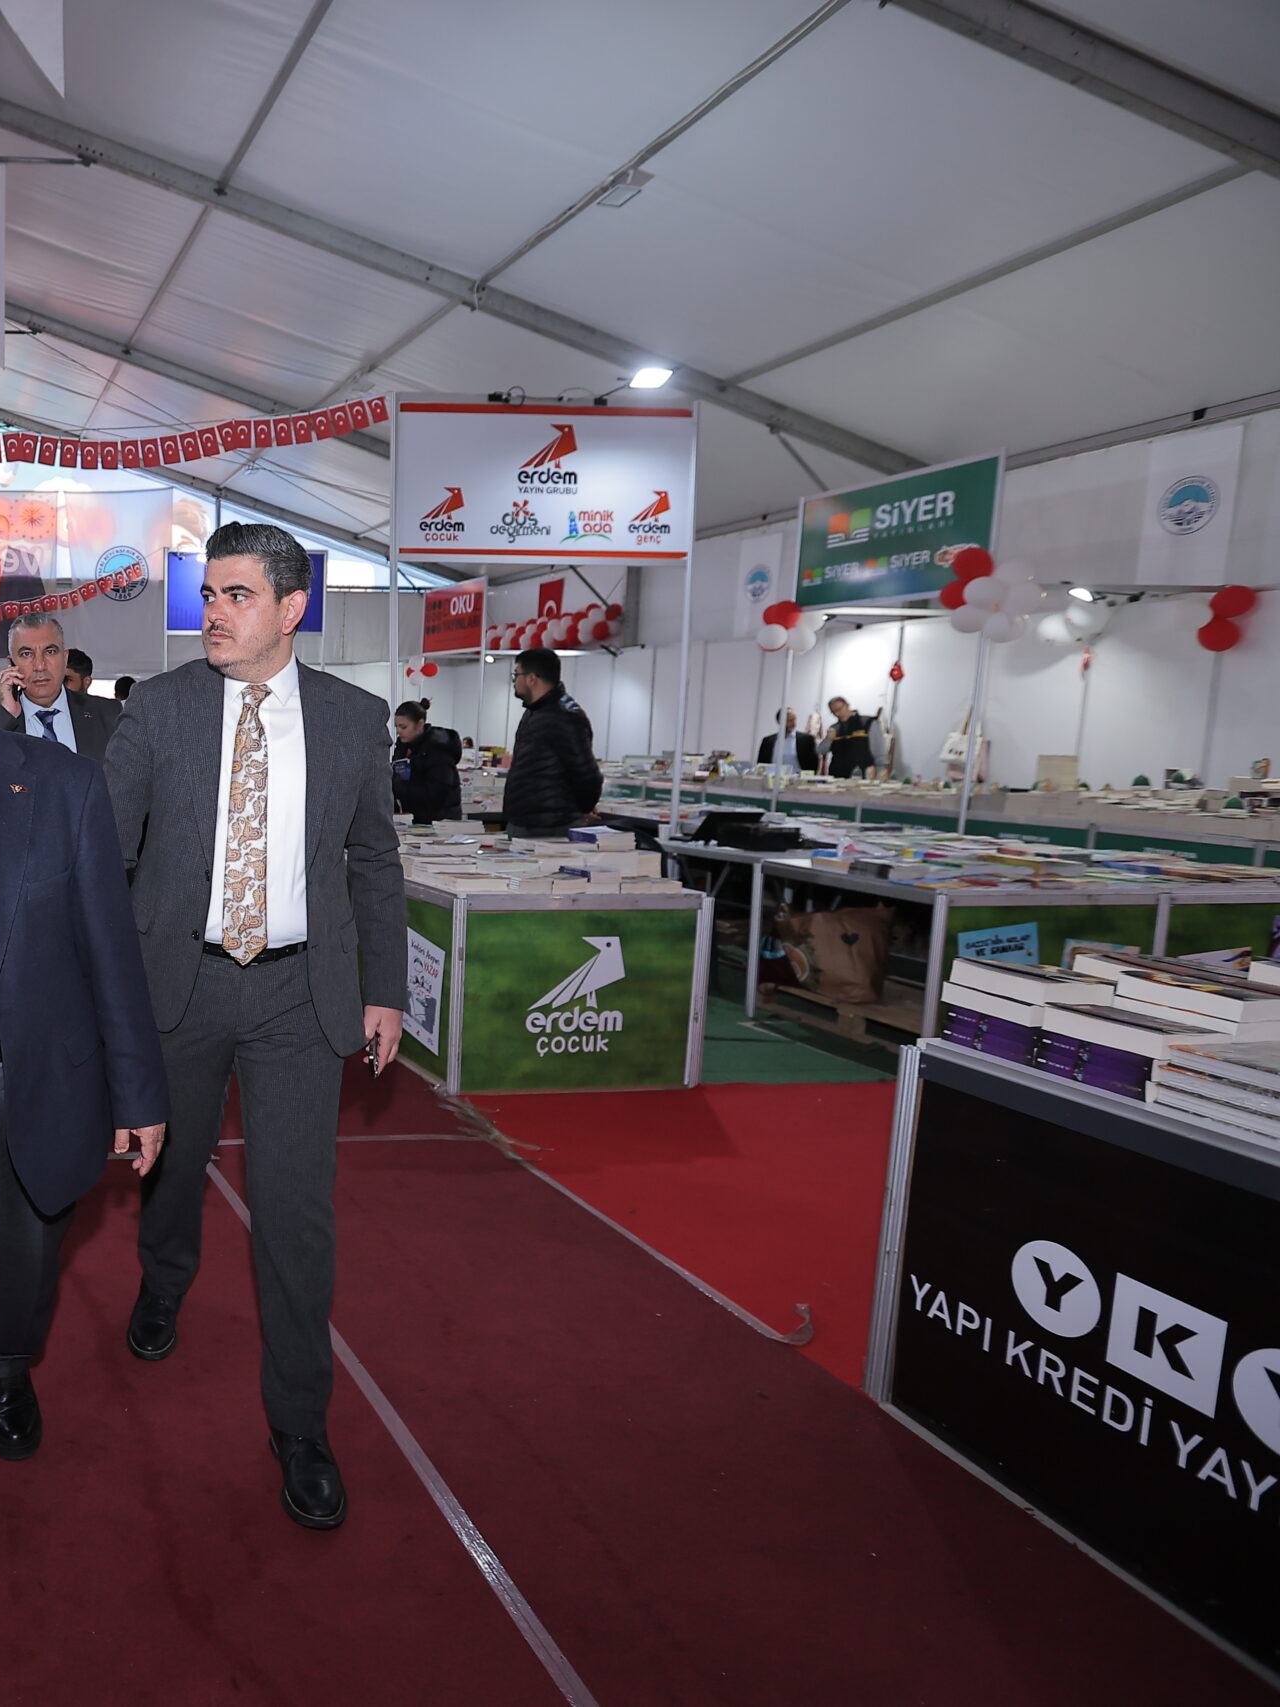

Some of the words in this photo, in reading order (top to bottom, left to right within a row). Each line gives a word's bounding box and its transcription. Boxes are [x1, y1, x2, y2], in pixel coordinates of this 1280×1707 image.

[518, 467, 578, 485] erdem
[518, 486, 544, 495] YAYIN
[546, 487, 578, 496] GRUBU
[578, 510, 614, 522] minik
[419, 519, 465, 533] erdem
[583, 521, 612, 534] ada
[628, 520, 671, 535] erdem
[424, 532, 460, 542] çocuk
[635, 533, 661, 545] genç
[449, 592, 476, 616] OKU
[525, 1005, 624, 1034] erdem
[536, 1033, 610, 1057] çocuk
[909, 1273, 993, 1353] YAPI
[1004, 1329, 1154, 1447] KREDİ
[1169, 1419, 1280, 1513] YAY
